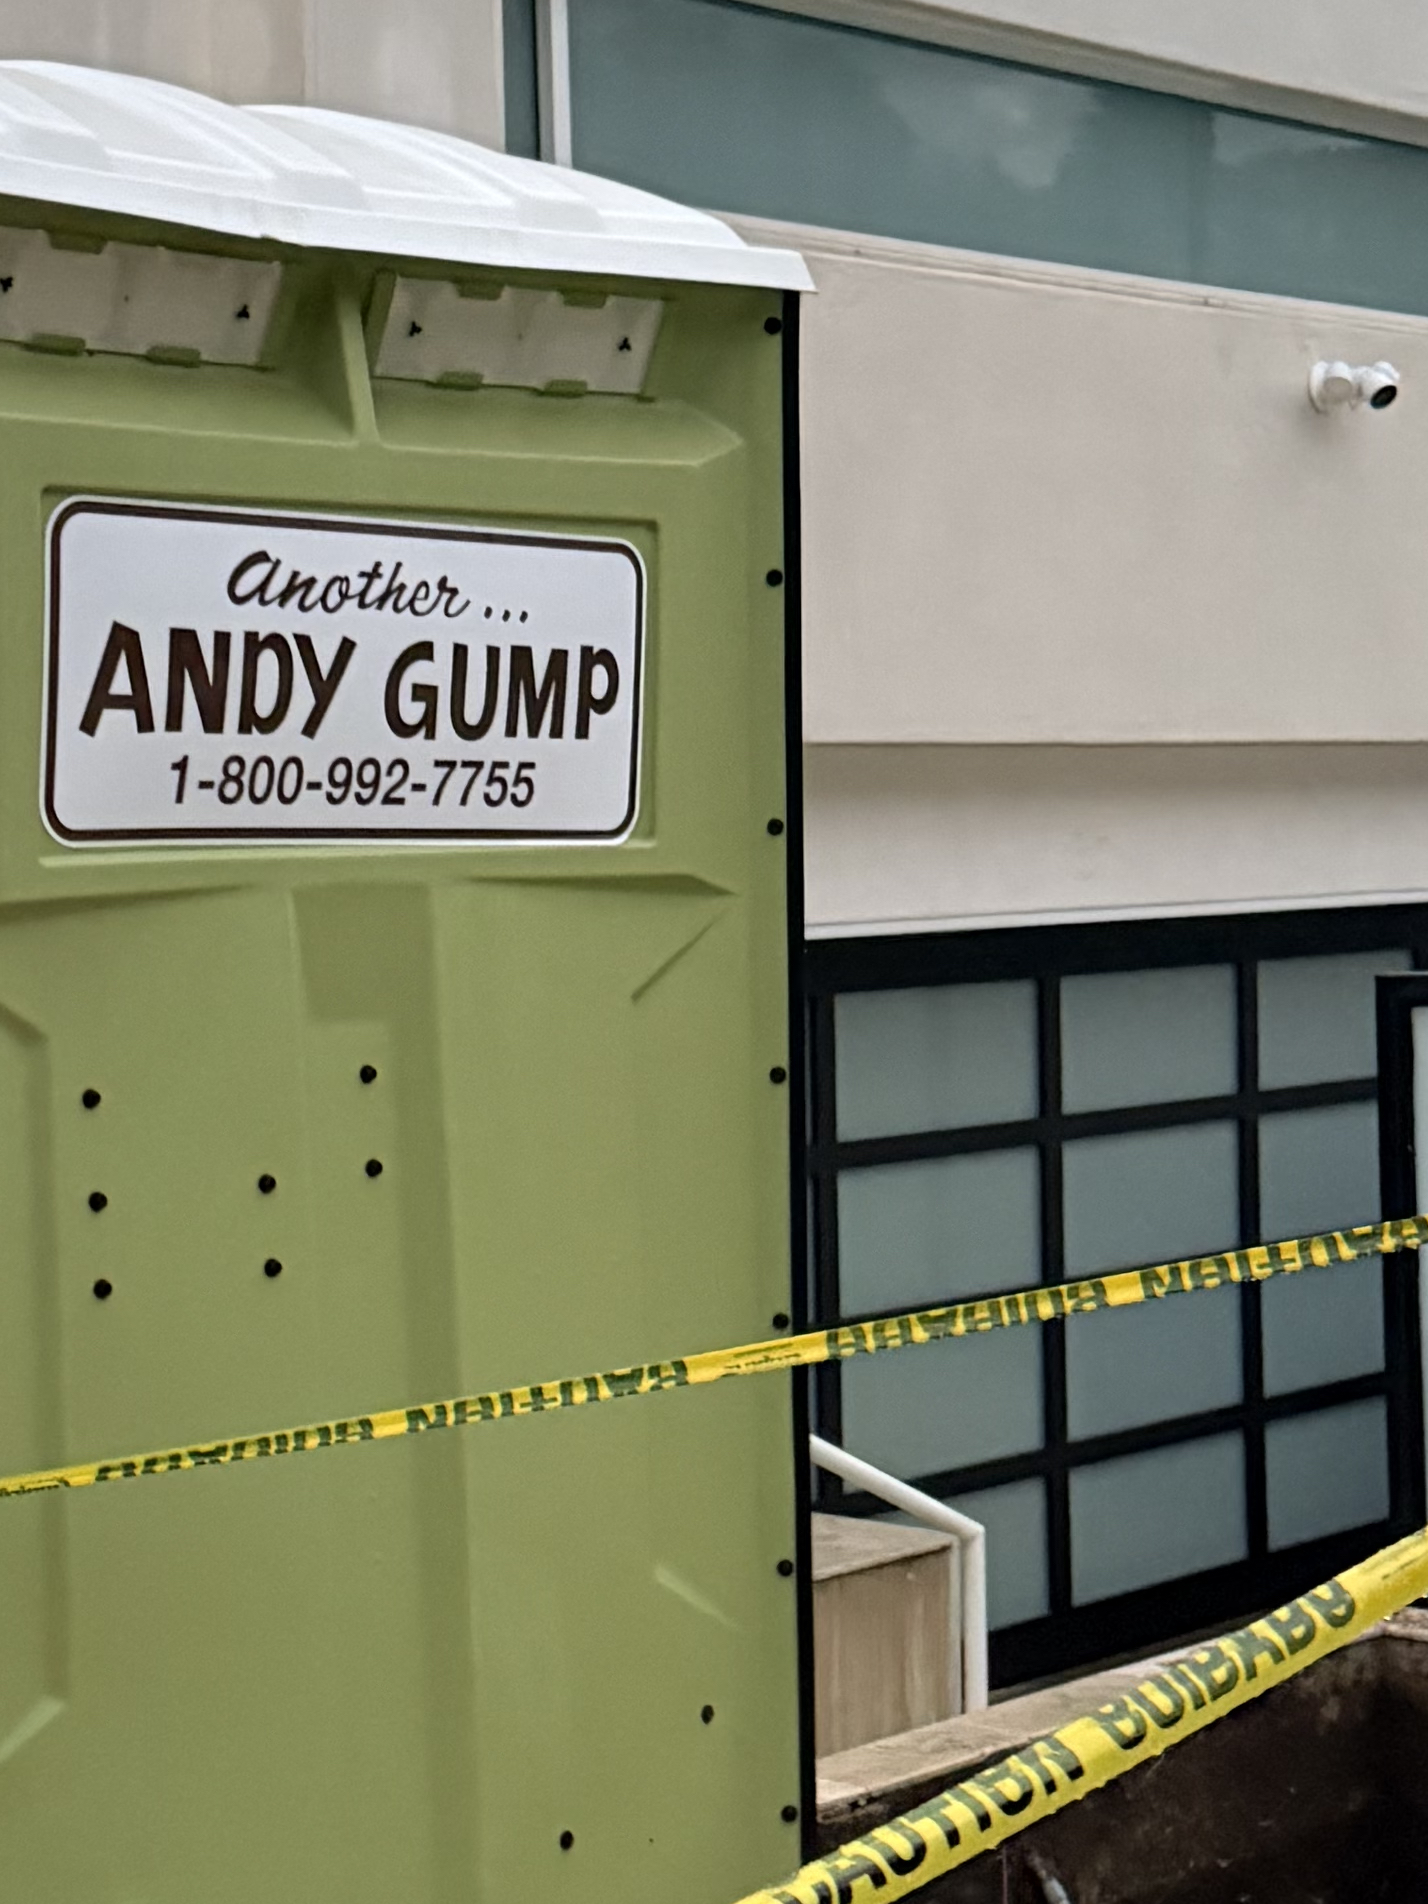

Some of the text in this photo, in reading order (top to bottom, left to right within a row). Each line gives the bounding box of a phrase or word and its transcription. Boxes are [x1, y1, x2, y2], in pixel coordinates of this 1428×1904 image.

[79, 621, 620, 741] ANDY GUMP
[171, 755, 536, 807] 1-800-992-7755
